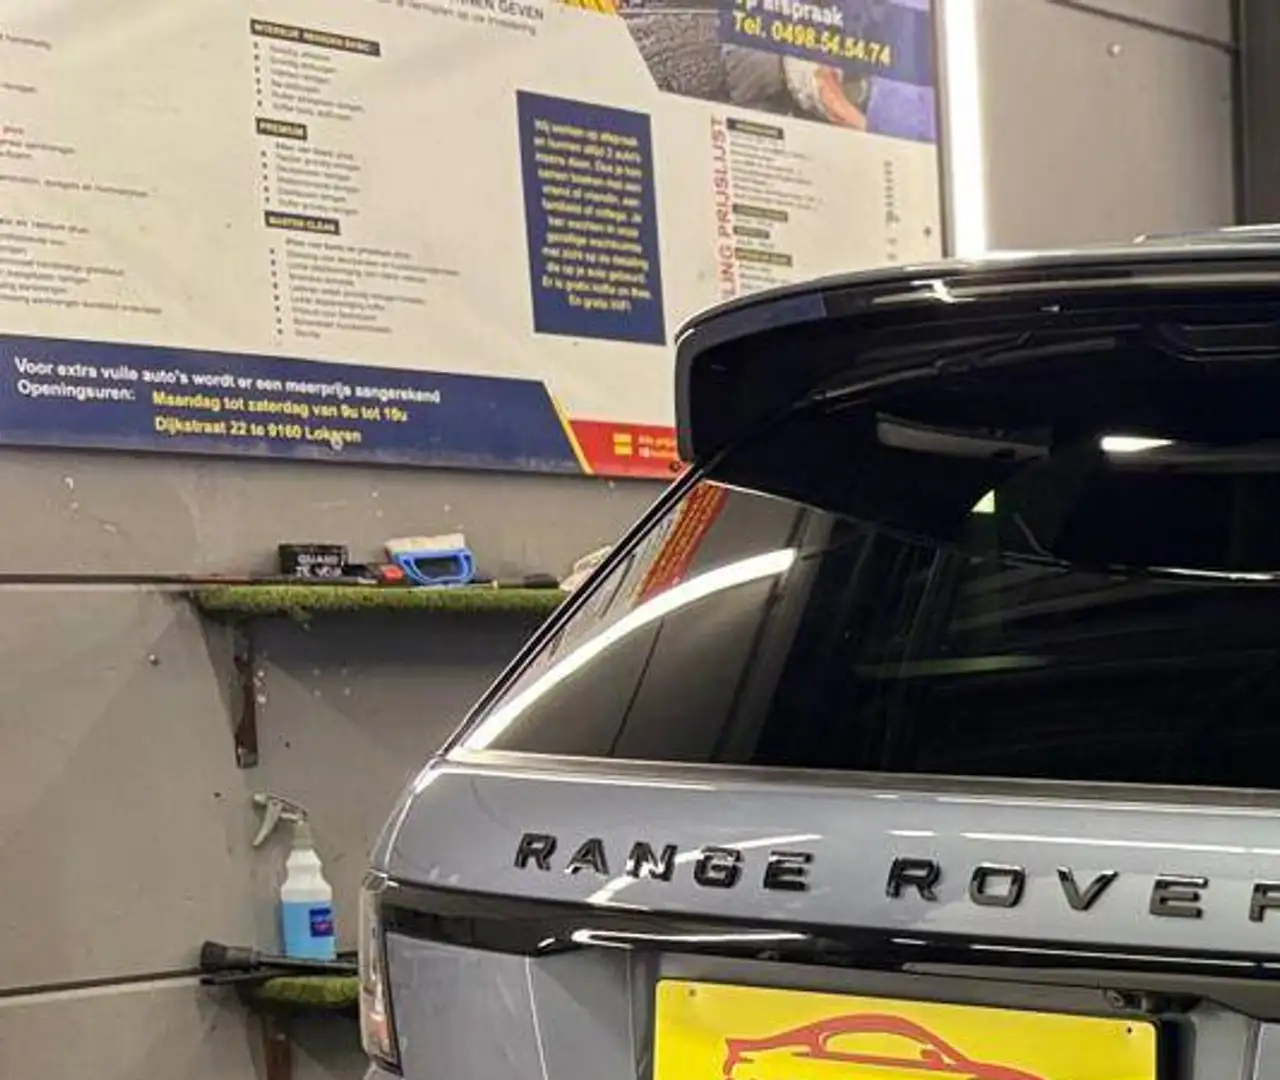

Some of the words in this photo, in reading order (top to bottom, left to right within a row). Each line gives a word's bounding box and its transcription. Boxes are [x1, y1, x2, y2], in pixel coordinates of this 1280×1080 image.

[732, 11, 767, 38] Tel.
[771, 20, 892, 67] 0498.54.54.74
[14, 355, 54, 376] Voor
[57, 363, 98, 379] extra
[141, 369, 188, 386] auto's
[192, 373, 235, 389] wordt
[237, 378, 253, 390] er
[255, 378, 283, 392] een
[285, 380, 351, 400] meerprijs
[17, 378, 136, 402] Openingsuren:
[152, 390, 221, 412] Maandag
[224, 396, 244, 410] tot
[247, 398, 309, 419] zaterdag
[312, 404, 338, 417] van
[361, 407, 380, 421] tot
[155, 415, 226, 435] Dijkstraat
[229, 420, 247, 436] 22
[513, 831, 815, 893] RANGE
